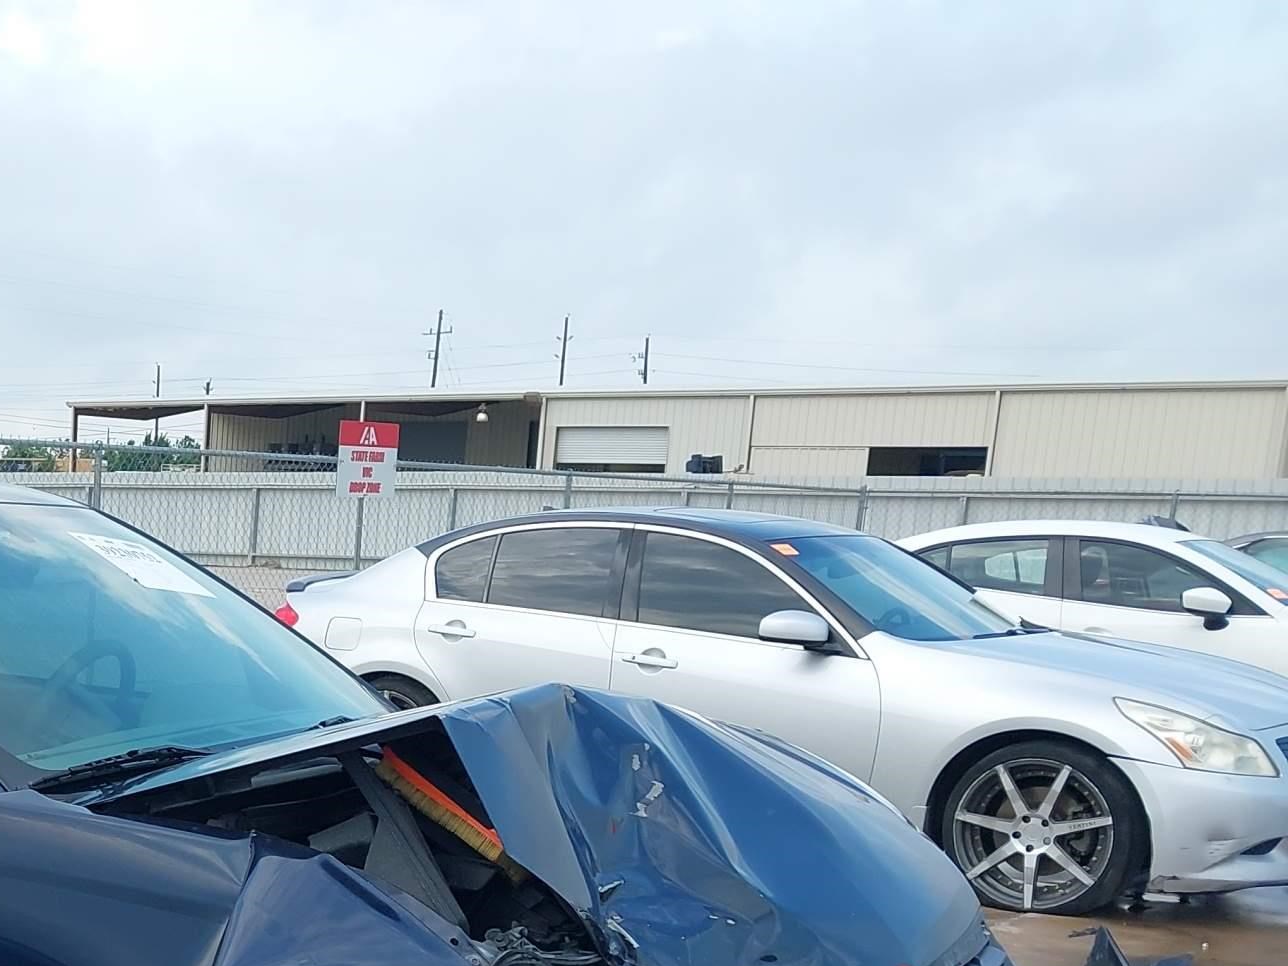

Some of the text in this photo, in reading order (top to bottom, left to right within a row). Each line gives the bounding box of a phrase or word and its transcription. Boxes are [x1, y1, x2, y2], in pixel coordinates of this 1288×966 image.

[350, 450, 385, 463] STATE FARM
[349, 482, 381, 494] DROP ZONE
